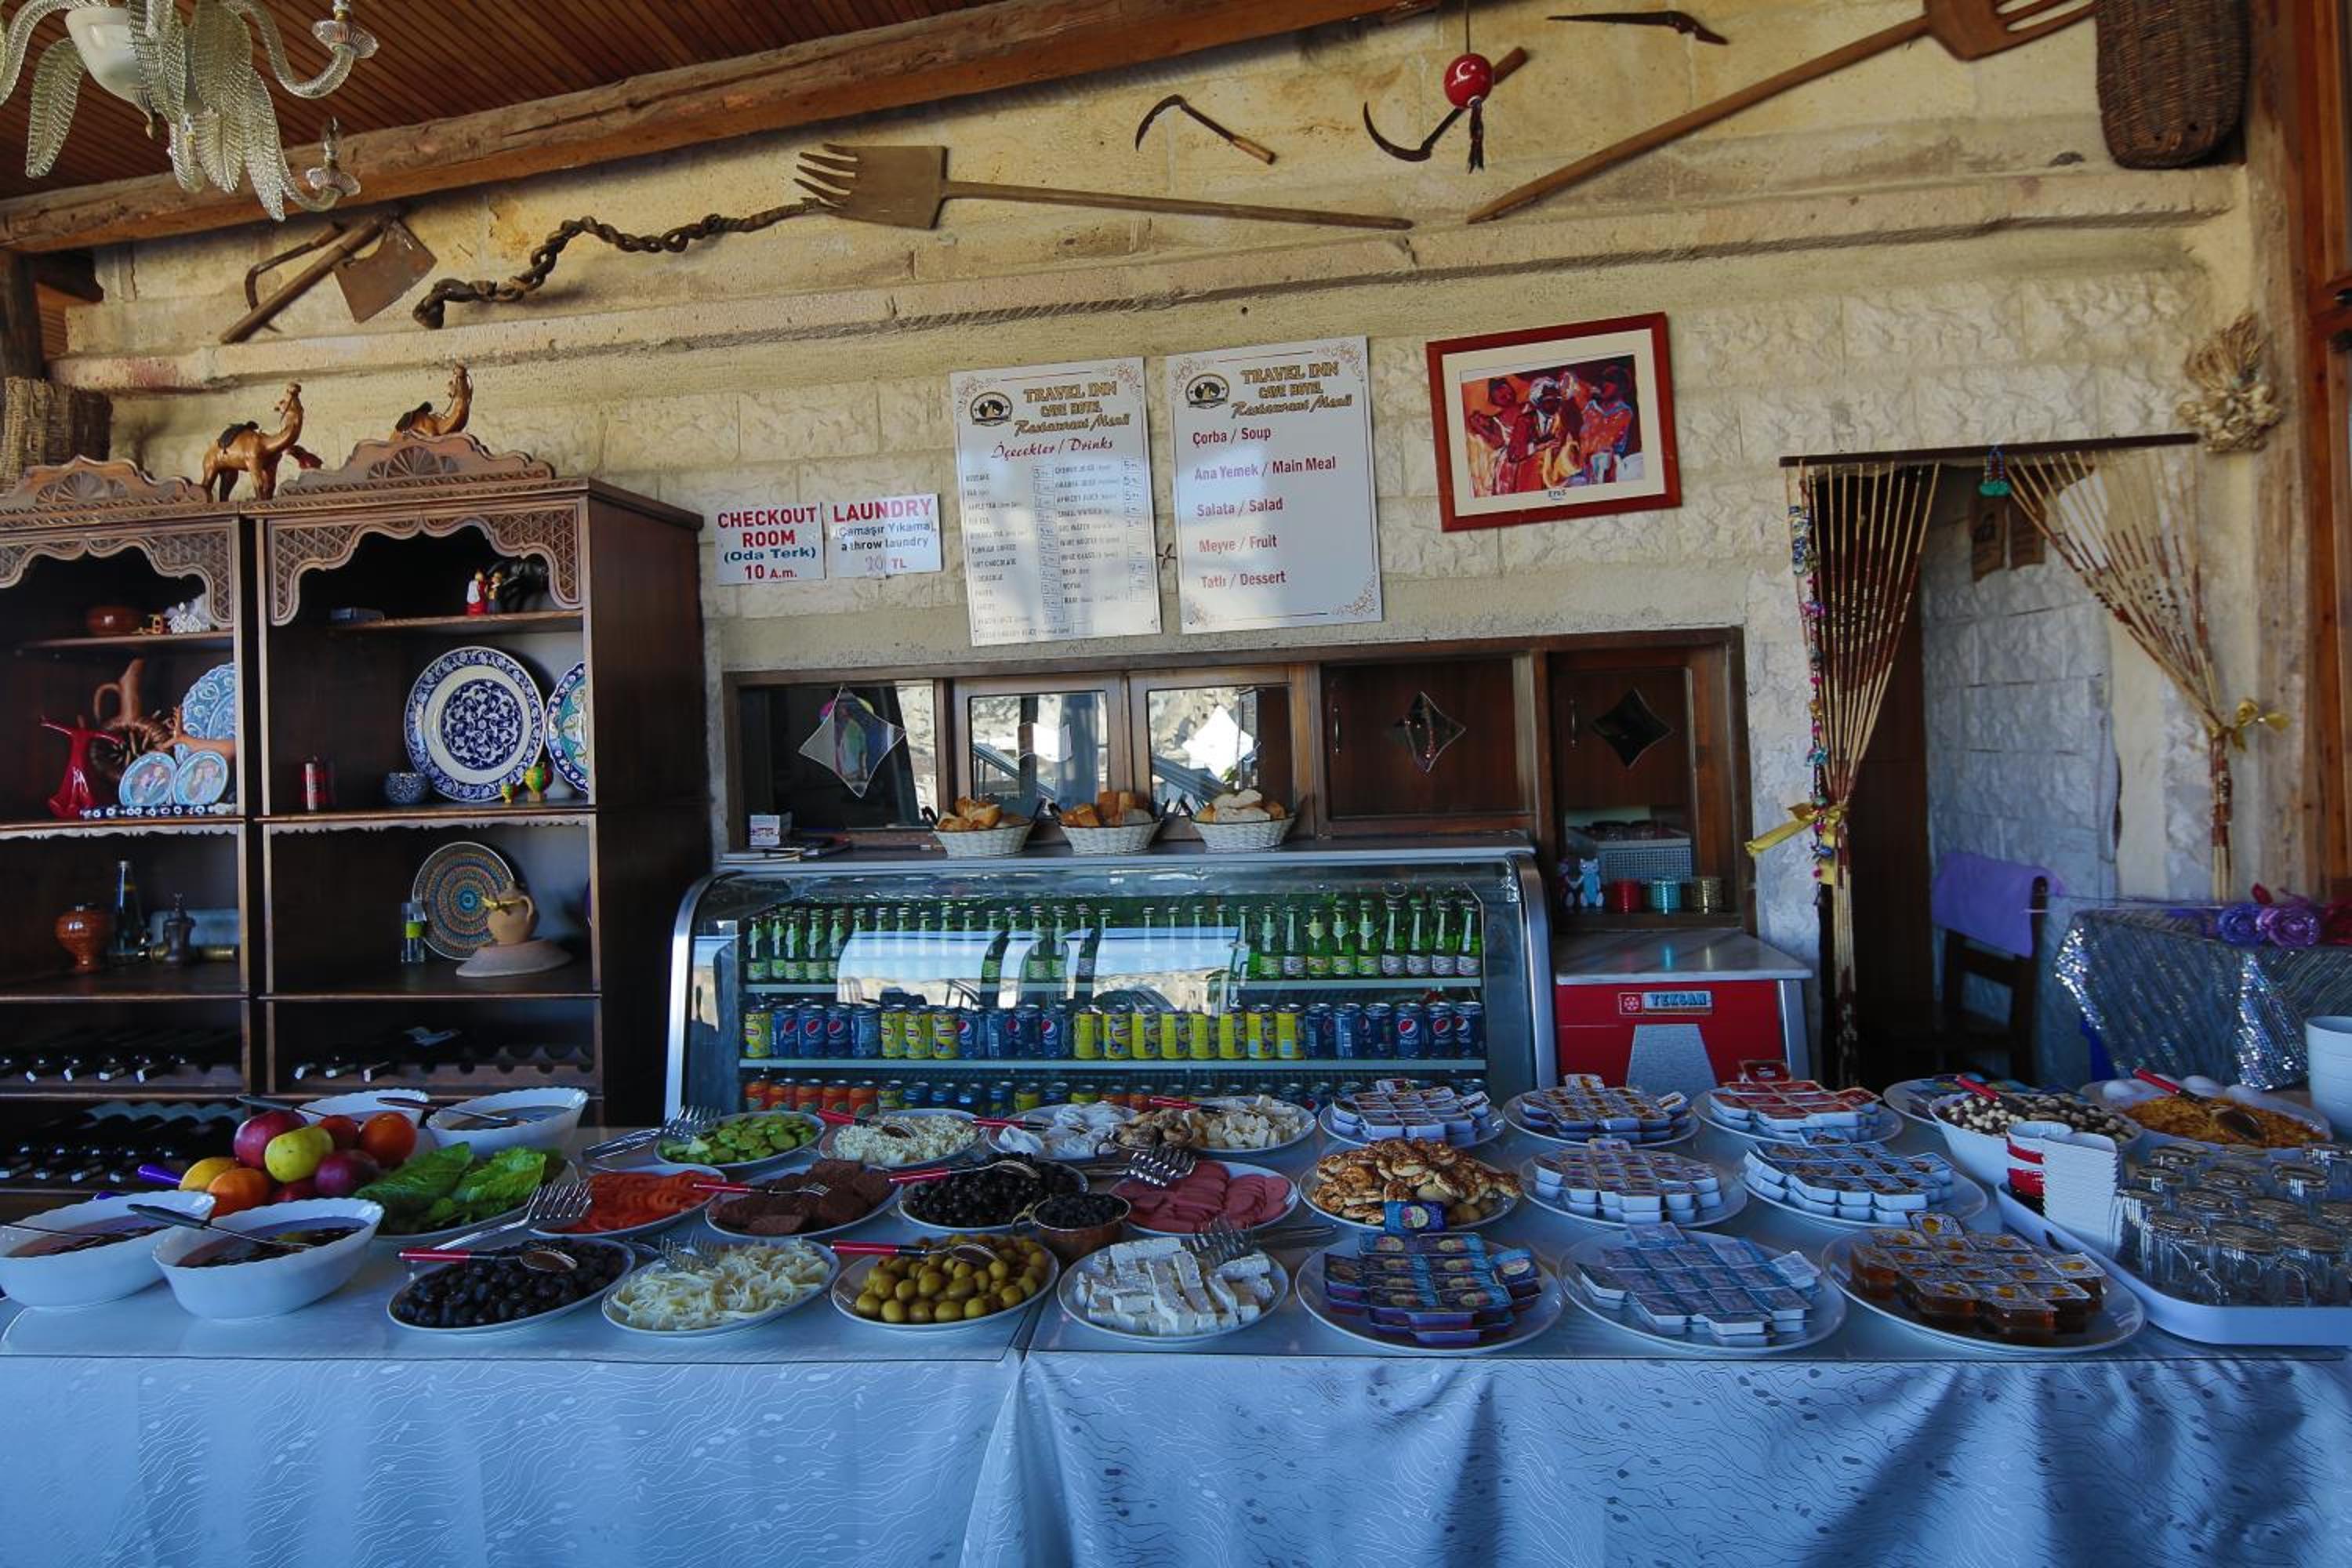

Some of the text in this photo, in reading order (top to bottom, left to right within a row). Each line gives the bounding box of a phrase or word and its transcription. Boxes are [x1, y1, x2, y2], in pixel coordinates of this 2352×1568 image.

[1240, 365, 1305, 384] TRAVEL
[1308, 361, 1338, 378] INN
[1024, 384, 1085, 403] TRAVEL
[1088, 381, 1117, 397] INN
[1259, 381, 1323, 399] CAVE HOTEL
[1069, 437, 1112, 451] Drinks
[1192, 431, 1227, 447] Çorba
[1241, 427, 1271, 441] Soup
[1195, 468, 1217, 481] Ana
[1219, 464, 1258, 478] Yemek
[1272, 459, 1302, 474] Main
[1305, 456, 1336, 471] Meal
[833, 498, 932, 522] LAUNDRY
[1197, 504, 1235, 517] Salata
[1249, 497, 1283, 513] Salad
[717, 507, 816, 528] CHECKOUT
[742, 529, 796, 548] ROOM
[885, 537, 929, 548] laundry
[1199, 539, 1236, 554] Meyve
[1249, 535, 1277, 548] Fruit
[724, 547, 816, 564] (Oda Terk)
[891, 557, 907, 569] TL
[745, 564, 764, 579] 10
[1240, 571, 1287, 586] Dessert
